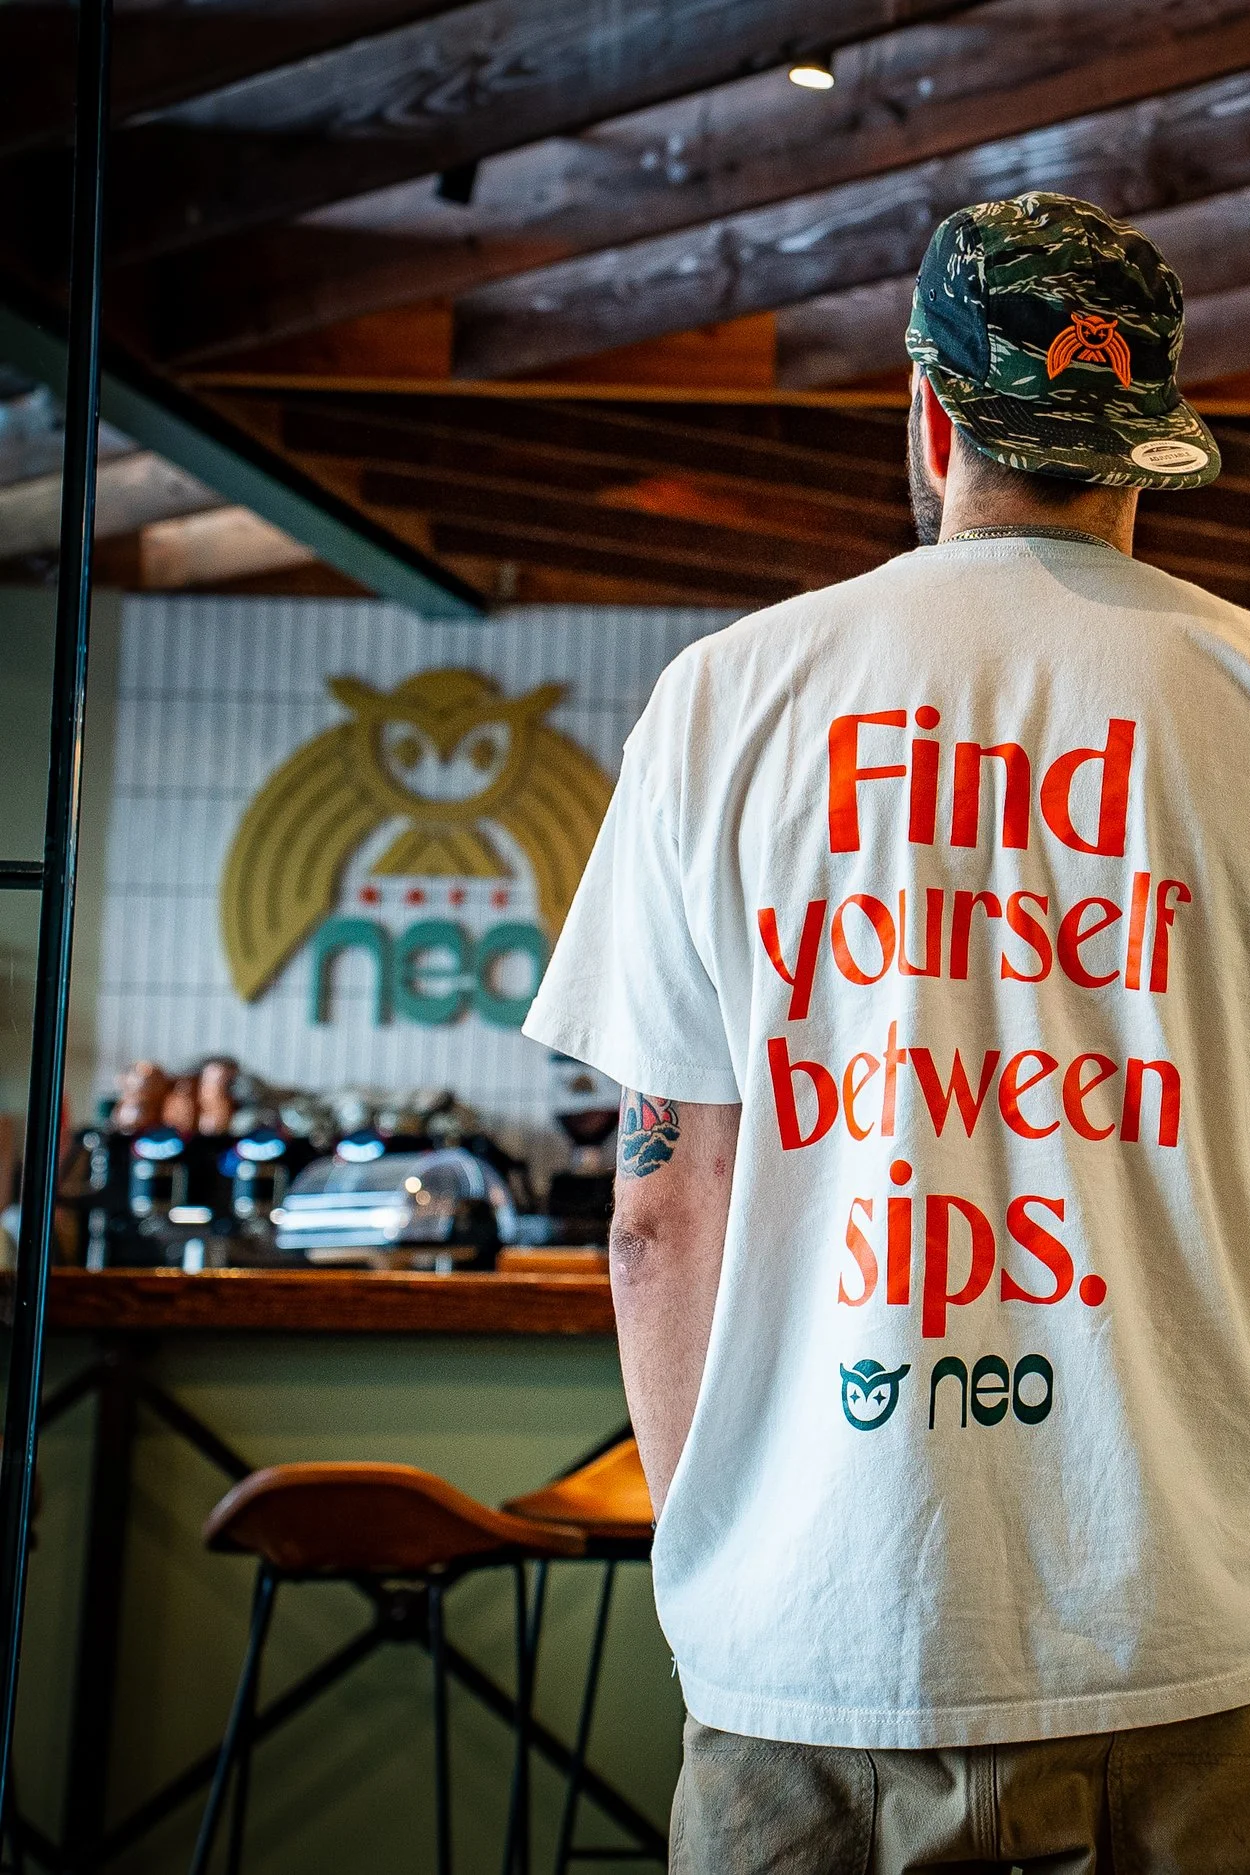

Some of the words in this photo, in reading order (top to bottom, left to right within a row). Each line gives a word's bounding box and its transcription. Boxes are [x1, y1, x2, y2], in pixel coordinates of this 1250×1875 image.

[828, 705, 1137, 858] Find
[311, 916, 548, 1031] neo
[757, 872, 1193, 1022] yourself
[767, 1021, 1182, 1151] between
[837, 1159, 1108, 1339] sips.
[929, 1354, 1054, 1430] neo
